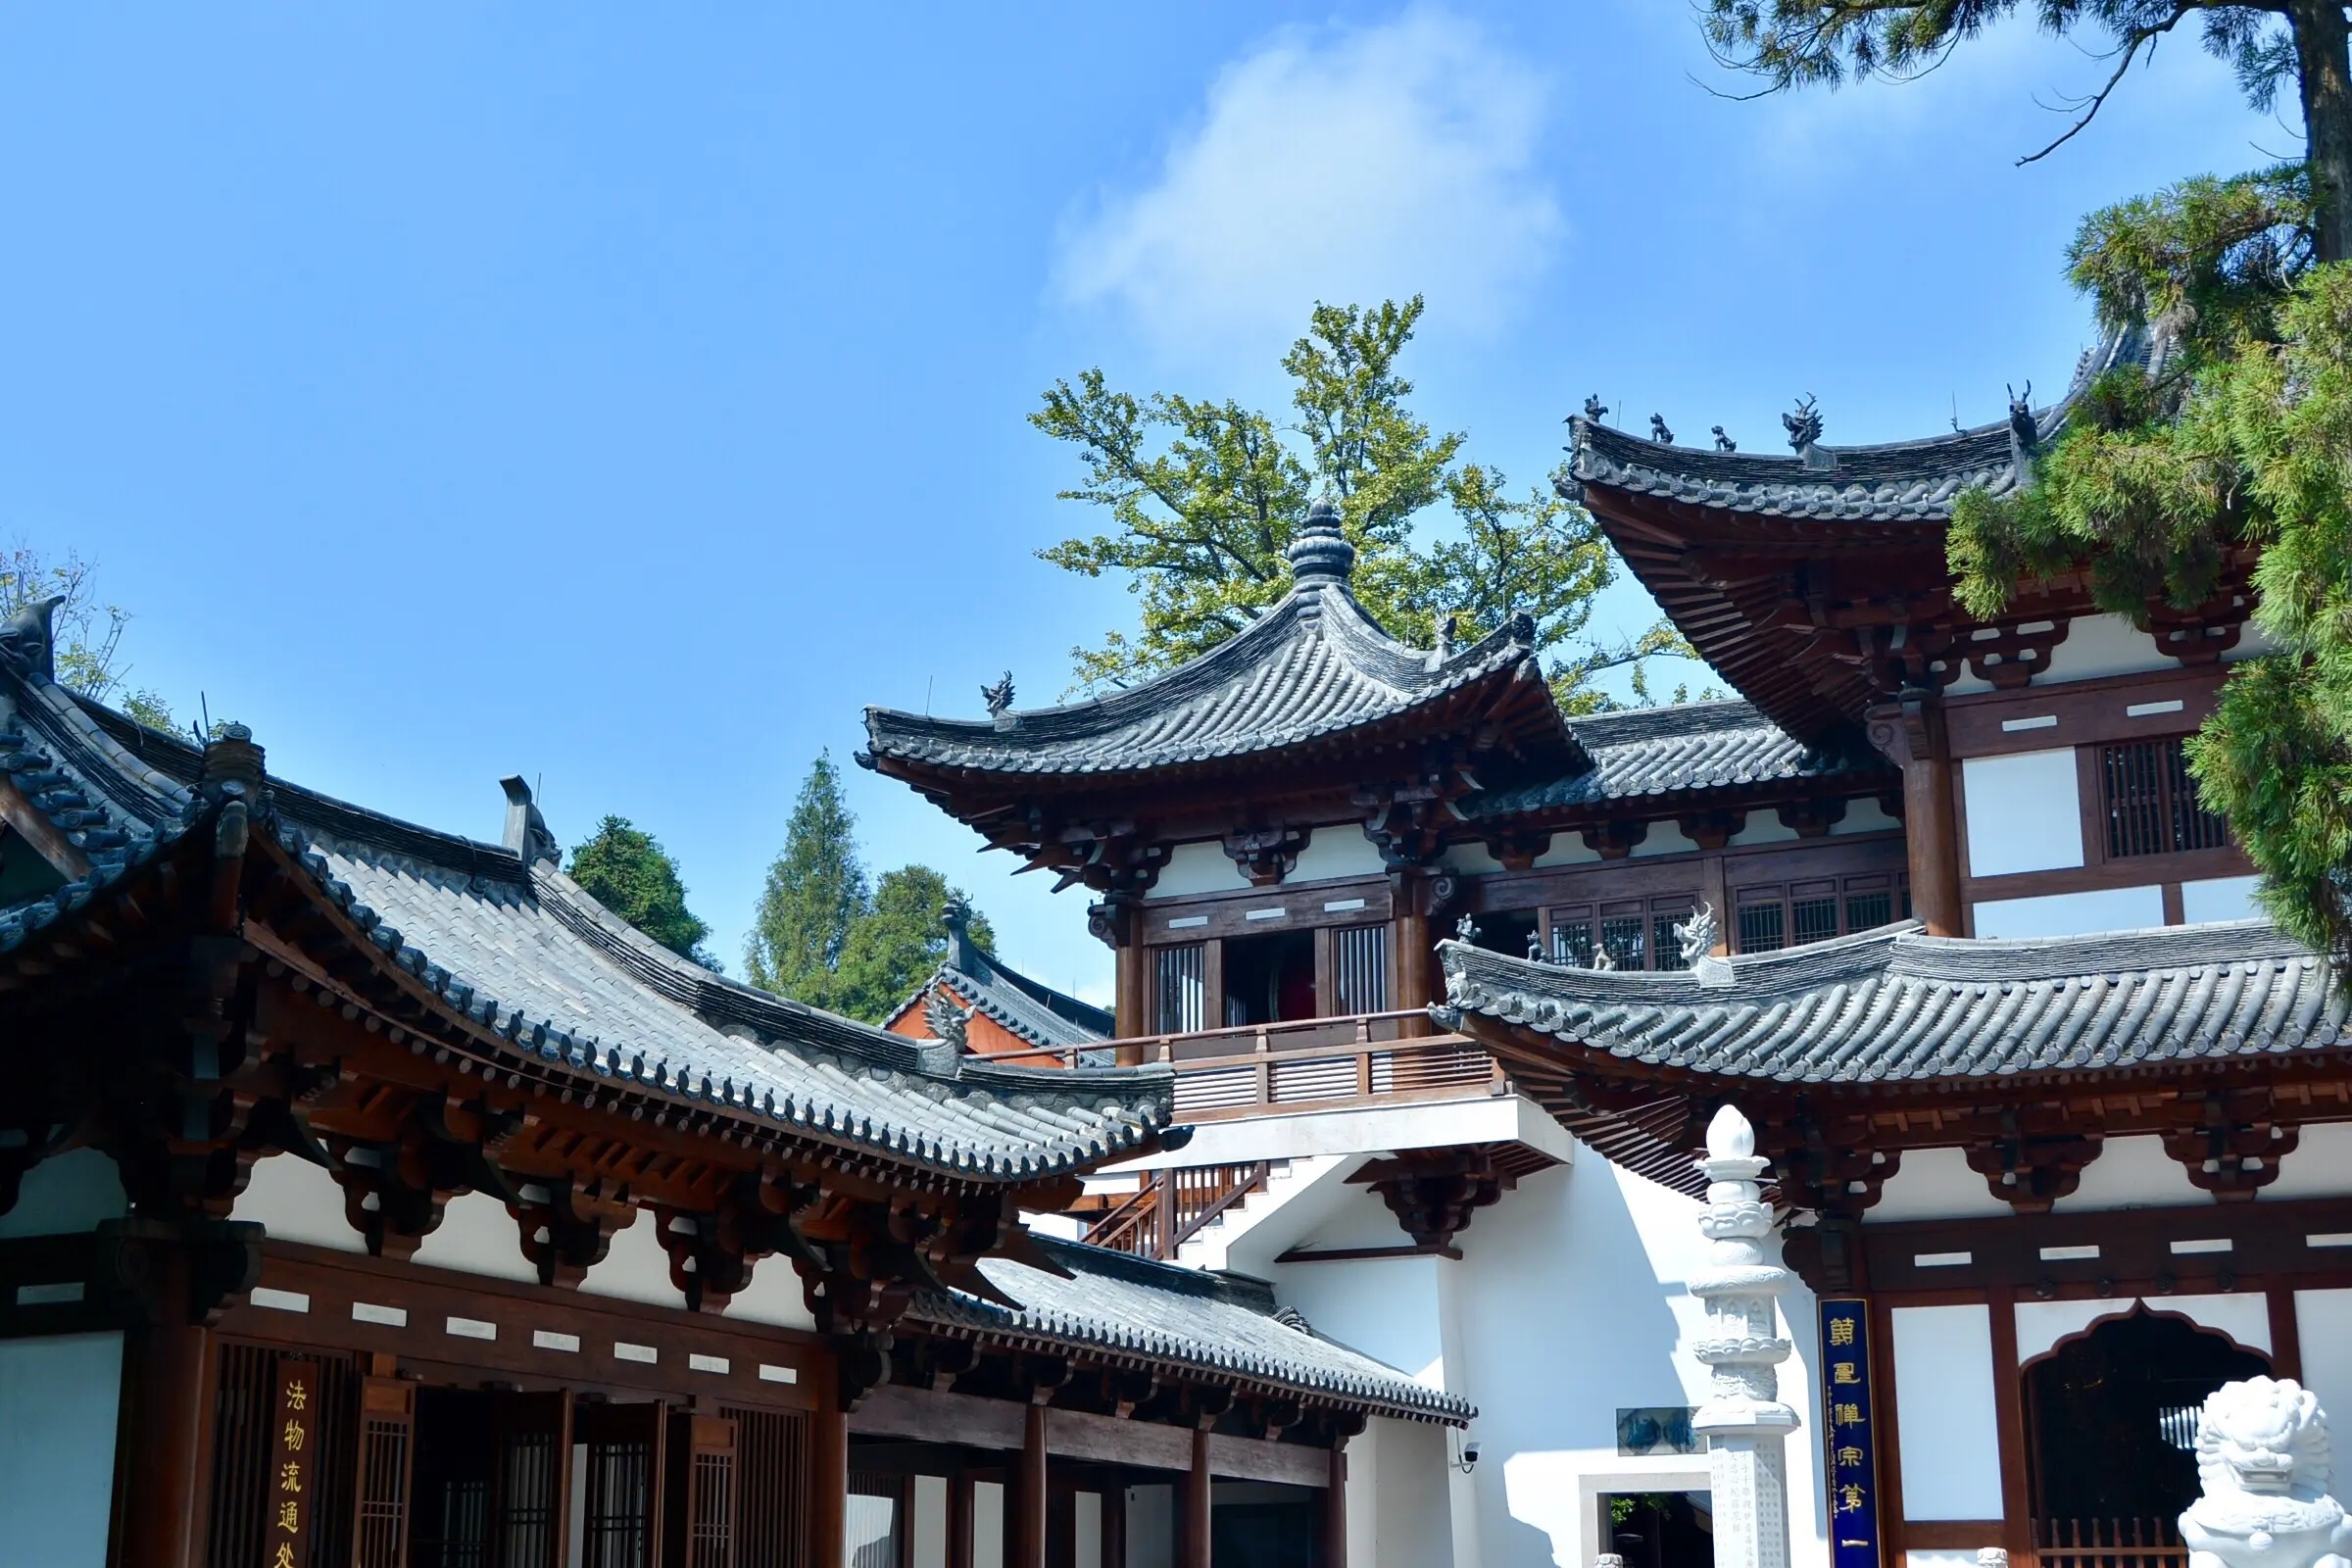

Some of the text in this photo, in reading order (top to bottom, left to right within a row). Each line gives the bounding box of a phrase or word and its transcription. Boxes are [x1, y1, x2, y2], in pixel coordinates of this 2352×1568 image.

[274, 1380, 308, 1568] 法物流通处
